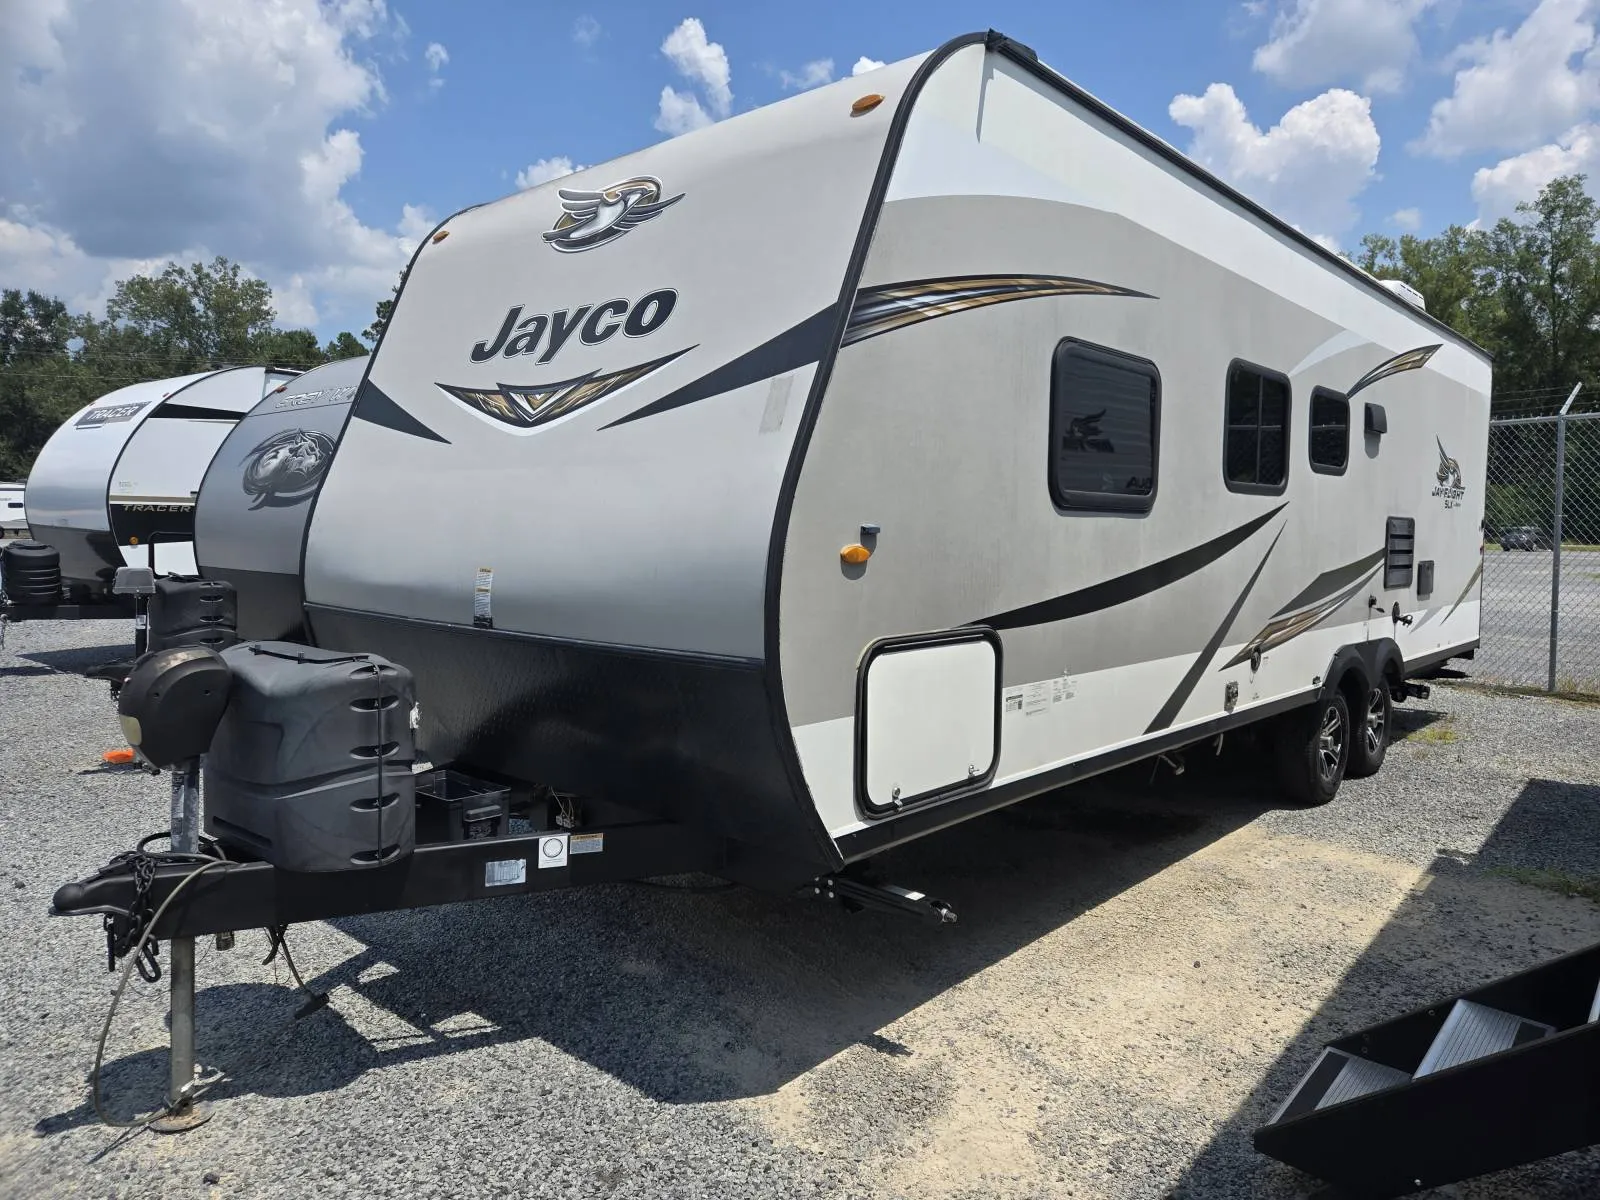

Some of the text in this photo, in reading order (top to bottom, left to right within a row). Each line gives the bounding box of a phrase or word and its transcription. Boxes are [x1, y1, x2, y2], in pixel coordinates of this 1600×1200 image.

[470, 288, 678, 365] Jayco
[88, 406, 138, 420] TRACER
[122, 503, 192, 513] TRACER
